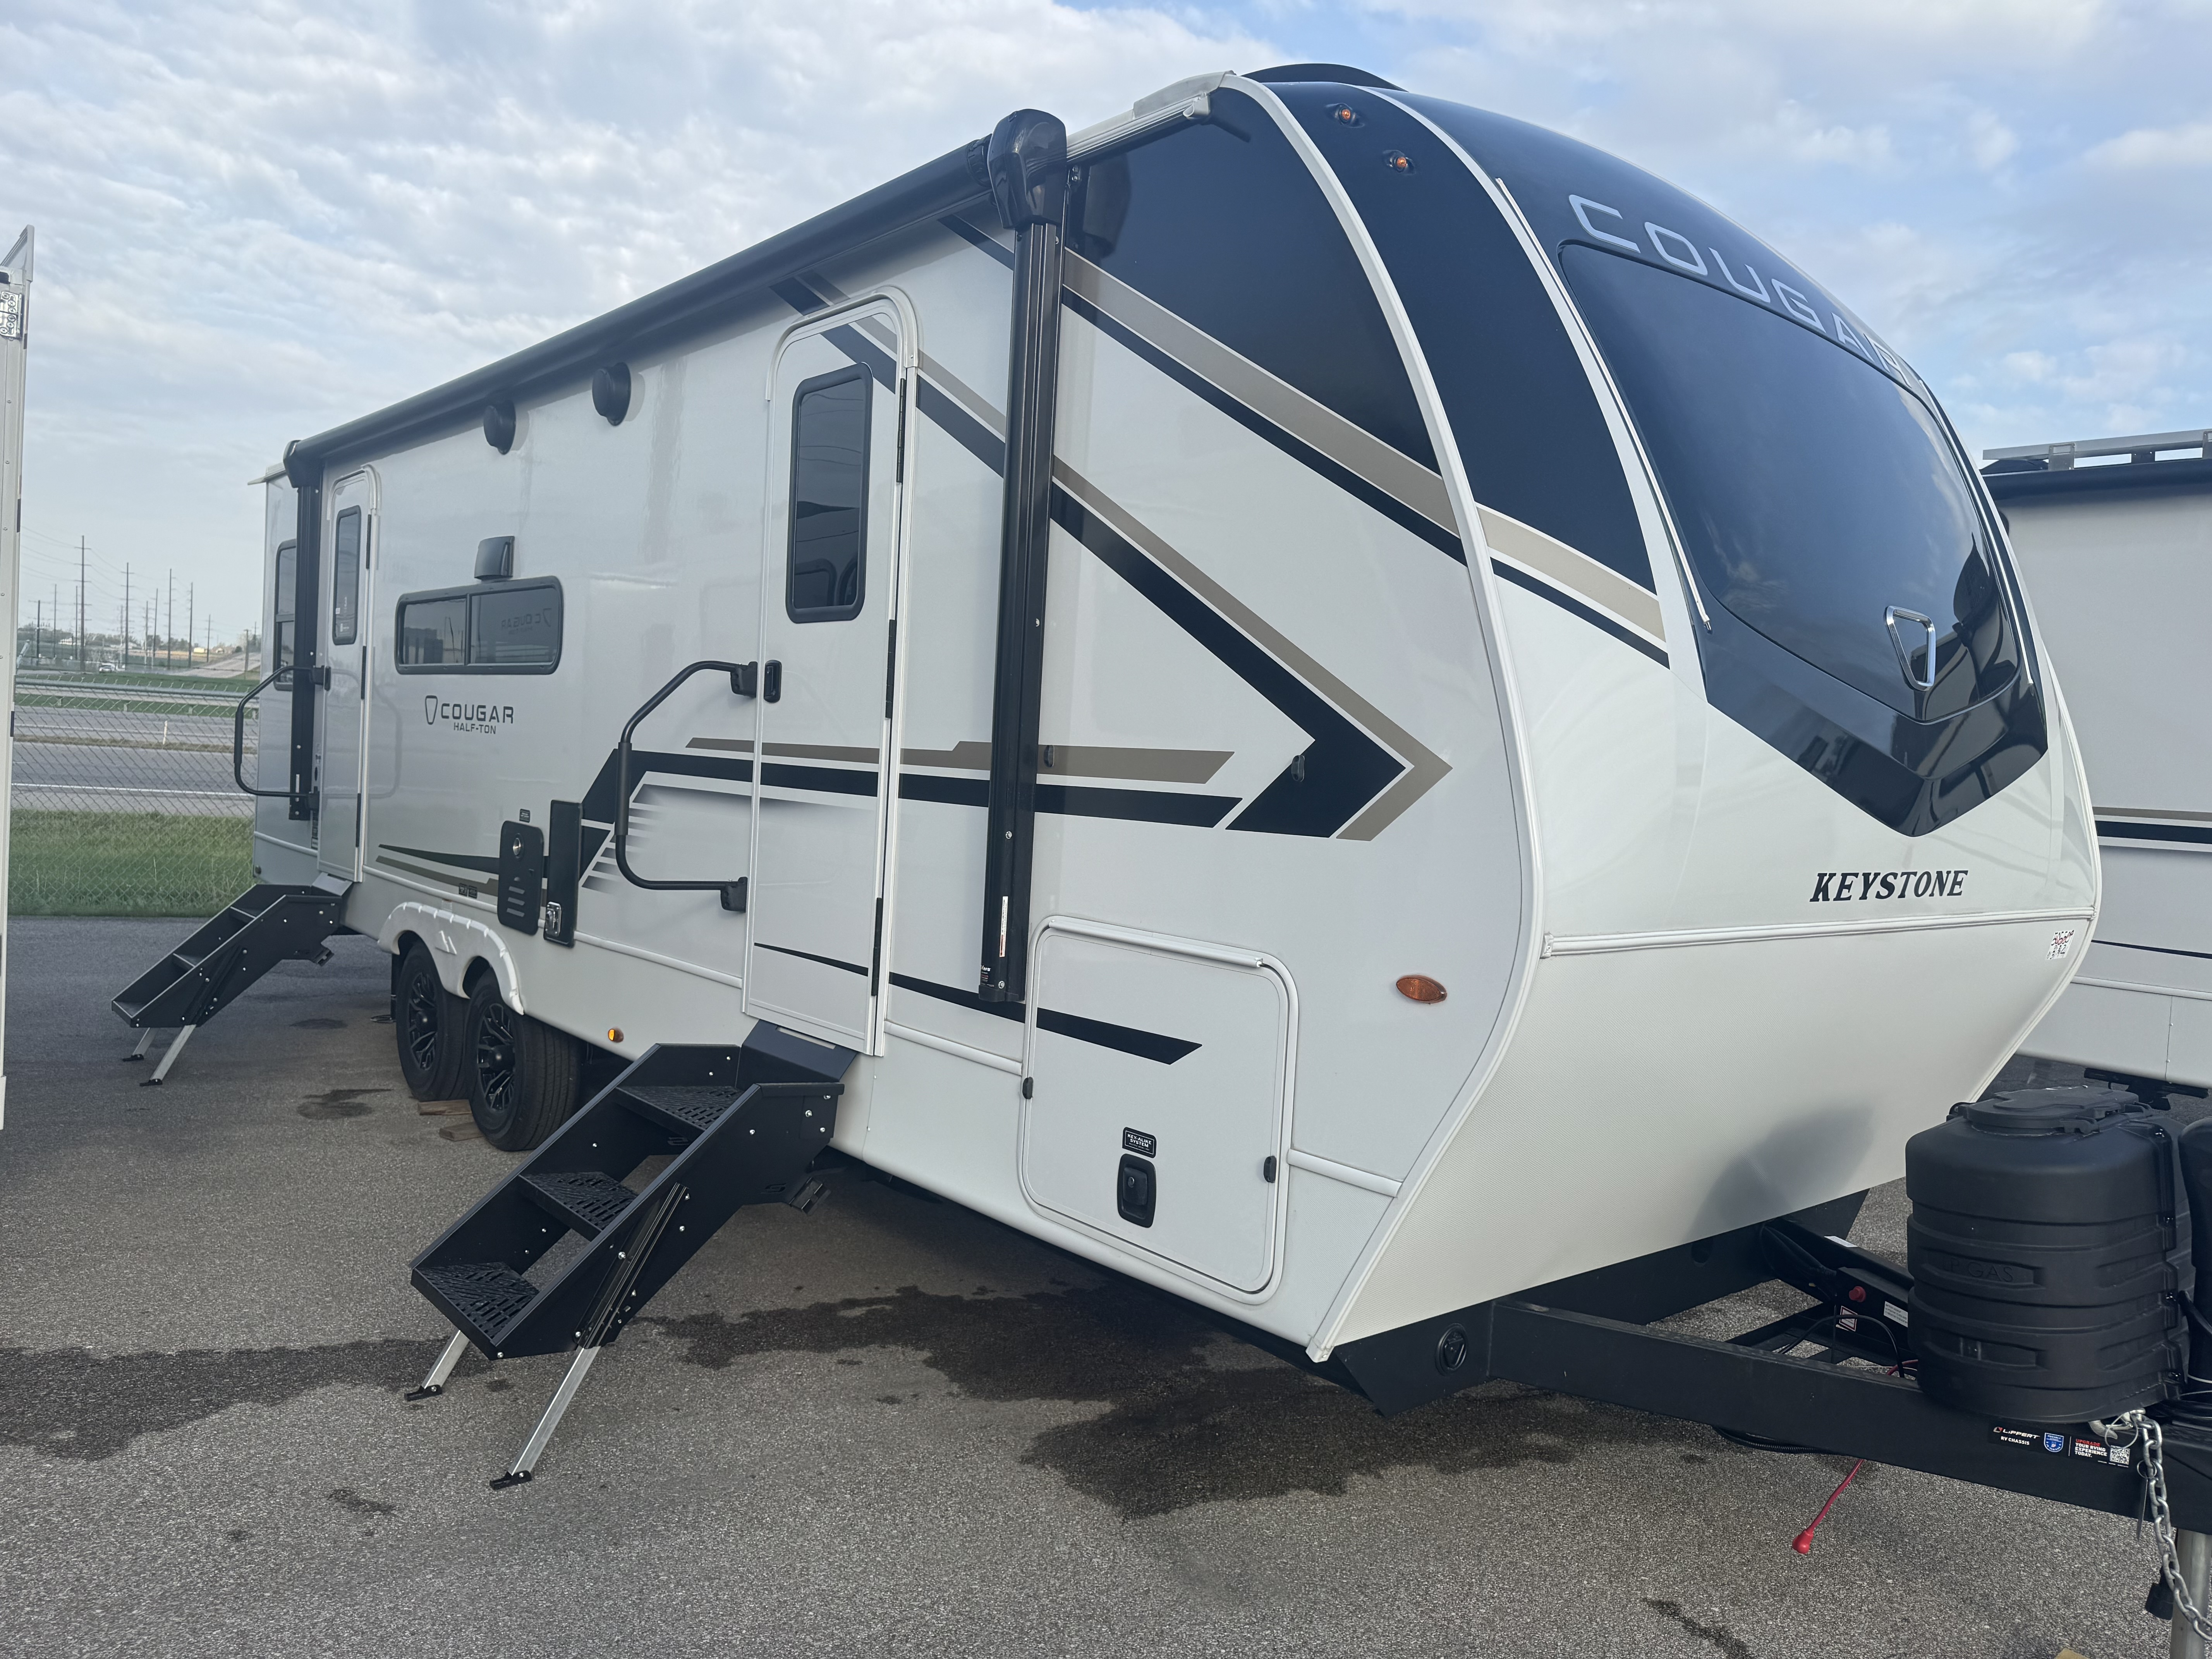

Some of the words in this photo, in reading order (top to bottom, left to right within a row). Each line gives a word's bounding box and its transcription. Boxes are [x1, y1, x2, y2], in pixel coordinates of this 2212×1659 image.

[1569, 194, 1912, 389] COUGAR
[441, 703, 514, 724] COUGAR
[453, 722, 496, 734] HALF-TON
[1809, 870, 1968, 902] KEYSTONE
[1130, 1139, 1149, 1148] SYSTEM
[1968, 1261, 2013, 1282] GAS
[2002, 1429, 2040, 1439] LIPPERT
[2075, 1447, 2107, 1456] EXPERIENCE
